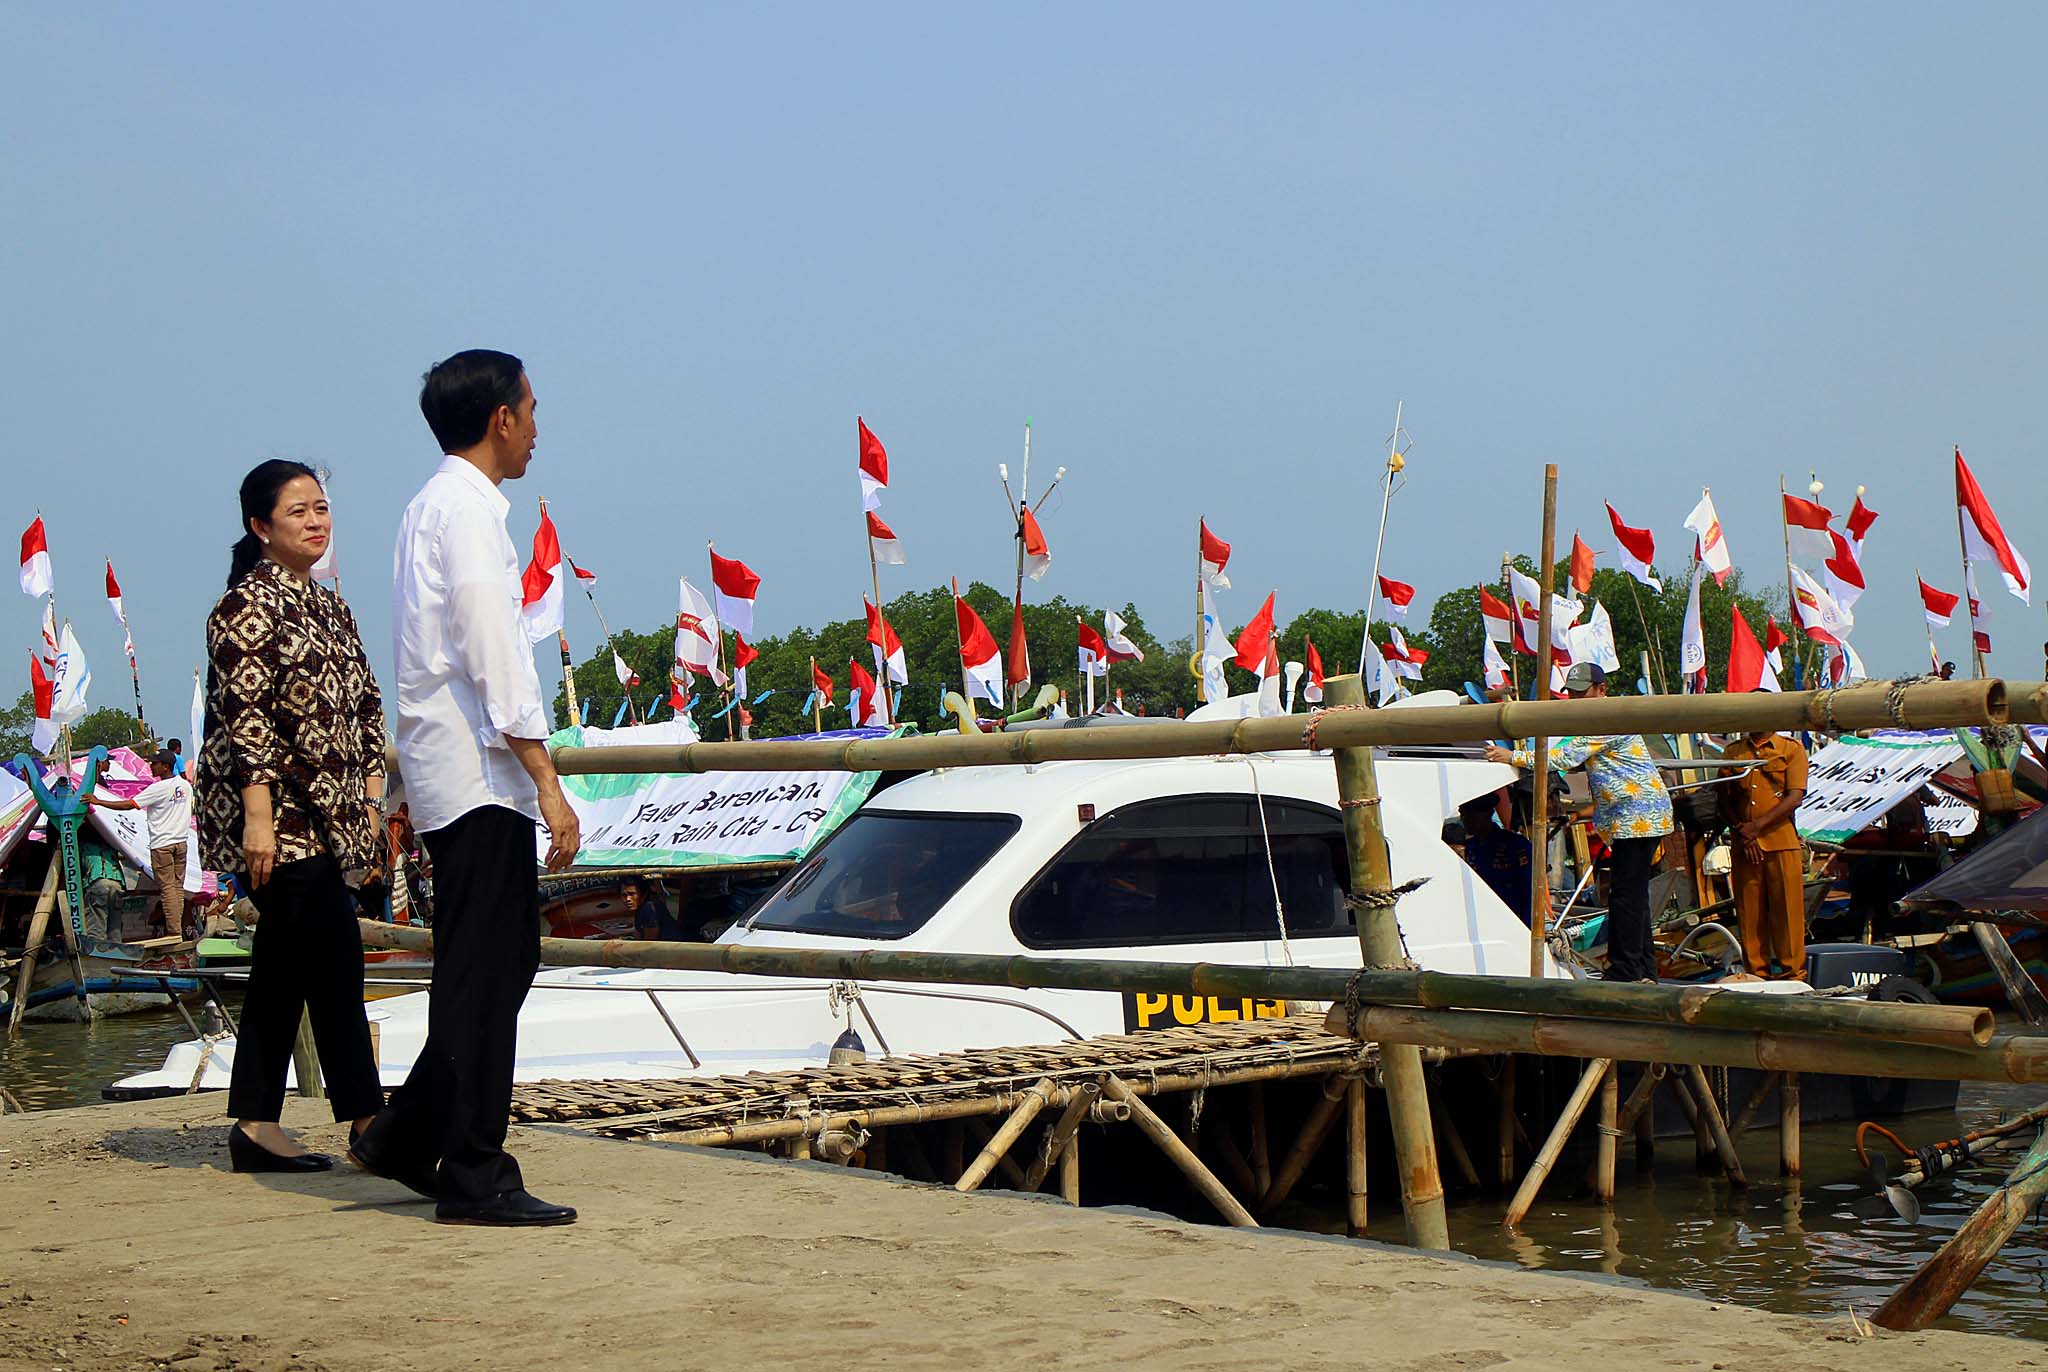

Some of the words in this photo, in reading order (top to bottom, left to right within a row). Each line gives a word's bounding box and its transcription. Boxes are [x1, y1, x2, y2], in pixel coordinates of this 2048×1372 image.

[629, 800, 690, 825] Yang
[671, 820, 719, 846] Raih
[719, 815, 769, 839] Cita
